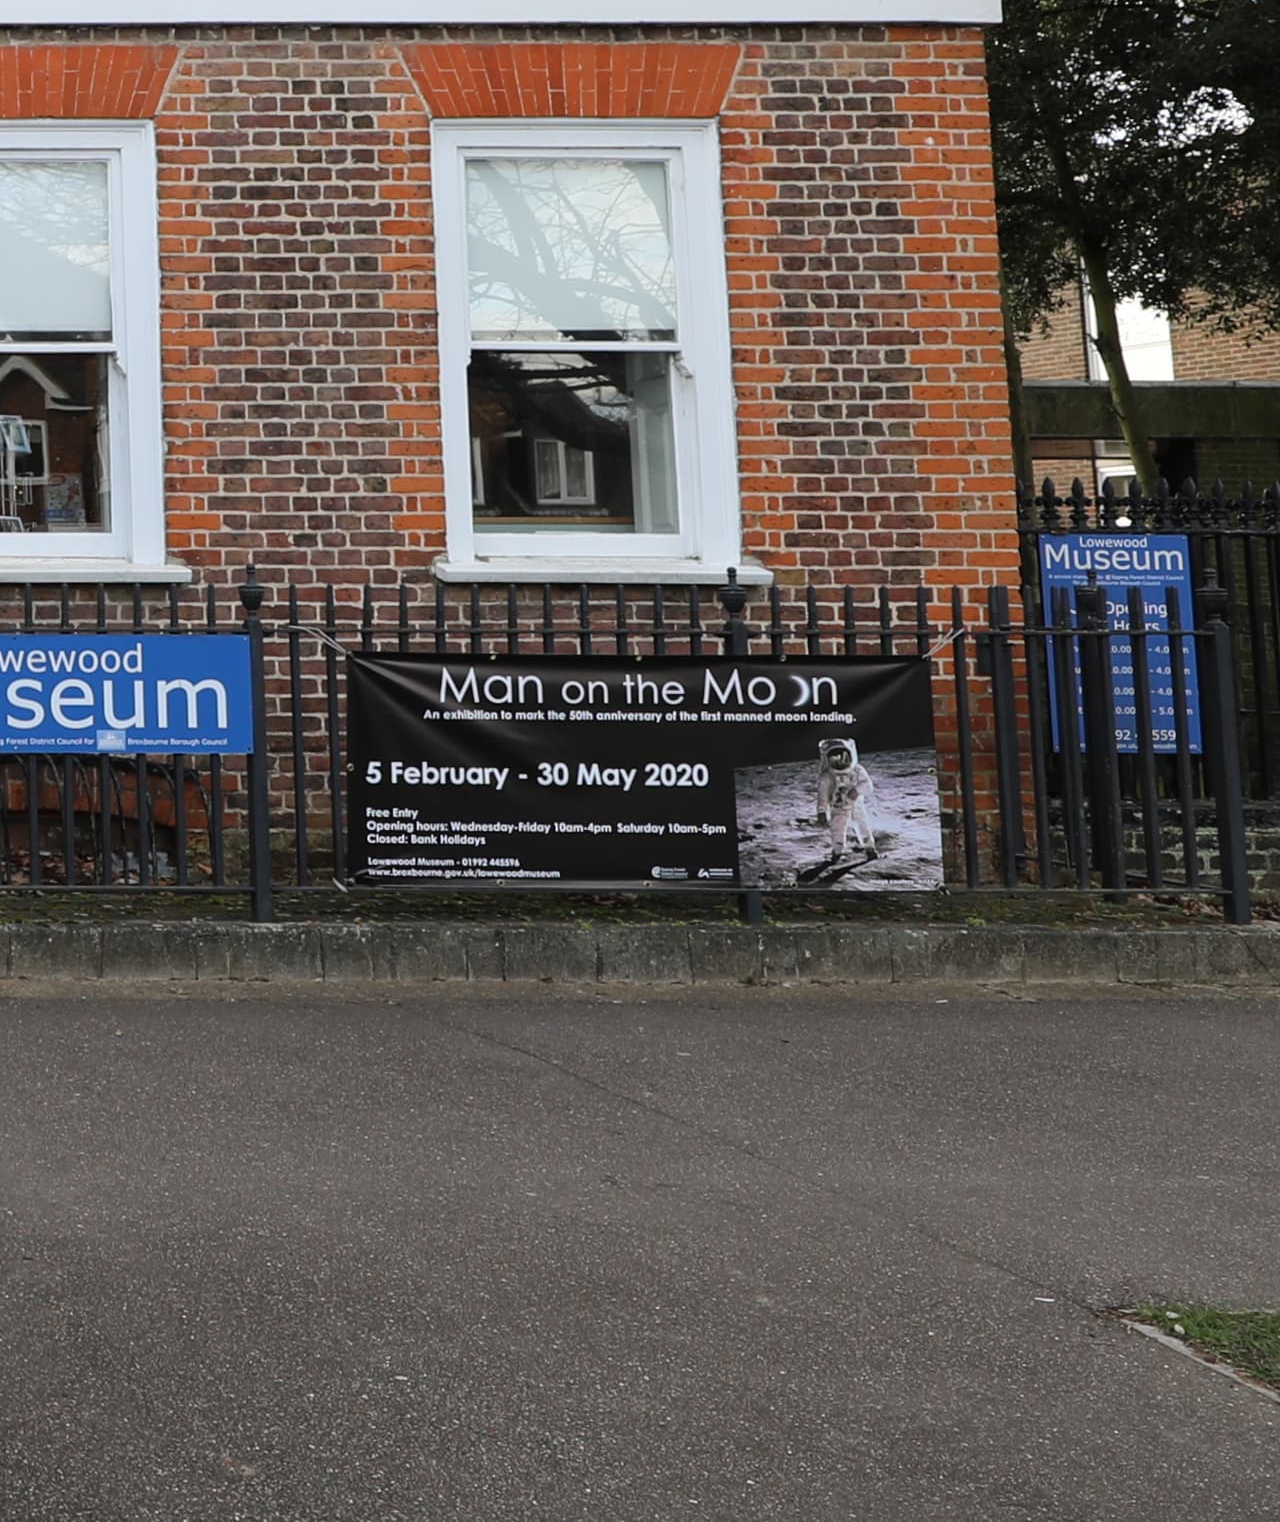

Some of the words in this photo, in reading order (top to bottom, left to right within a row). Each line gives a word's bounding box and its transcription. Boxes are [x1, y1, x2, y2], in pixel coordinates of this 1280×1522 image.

[1079, 535, 1148, 548] Lowewood
[1044, 543, 1184, 571] Museum
[1106, 601, 1168, 617] Oping
[440, 667, 544, 704] Man
[561, 681, 609, 704] on
[623, 673, 685, 705] the
[423, 709, 440, 720] An
[443, 709, 498, 720] exhibition
[501, 710, 512, 720] to
[515, 710, 545, 720] mark
[547, 710, 566, 720] the
[569, 710, 594, 721] 50th
[596, 710, 662, 724] anniversary
[665, 710, 677, 721] of
[680, 710, 698, 721] the
[701, 711, 722, 721] first
[724, 711, 772, 722] manned
[775, 713, 807, 722] moon
[810, 712, 857, 724] landing.
[6, 737, 28, 745] Forest
[29, 737, 56, 745] District
[56, 737, 83, 745] Council
[83, 737, 95, 745] for
[127, 737, 169, 745] Broxbourne
[170, 738, 201, 747] Borough
[365, 761, 382, 784] 5
[391, 761, 510, 790] February
[537, 762, 570, 786] 30
[577, 763, 637, 791] May
[644, 763, 710, 787] 2020
[366, 807, 391, 818] Free
[392, 807, 419, 819] Entry
[366, 820, 415, 833] Opening
[416, 821, 449, 831] hours:
[450, 821, 551, 834] Wednesday-Friday
[554, 822, 612, 835] 10am-4pm
[617, 822, 665, 836] Saturday
[668, 823, 727, 836] 10am-5pm
[367, 834, 409, 844] Closed:
[410, 834, 438, 845] Bank
[440, 834, 486, 847] Holidays
[368, 857, 416, 866] Lowewood
[417, 857, 455, 867] Museum
[462, 858, 488, 867] 01992
[368, 867, 561, 878] www.broxbourne.gov.uk/lowewoodmuseum
